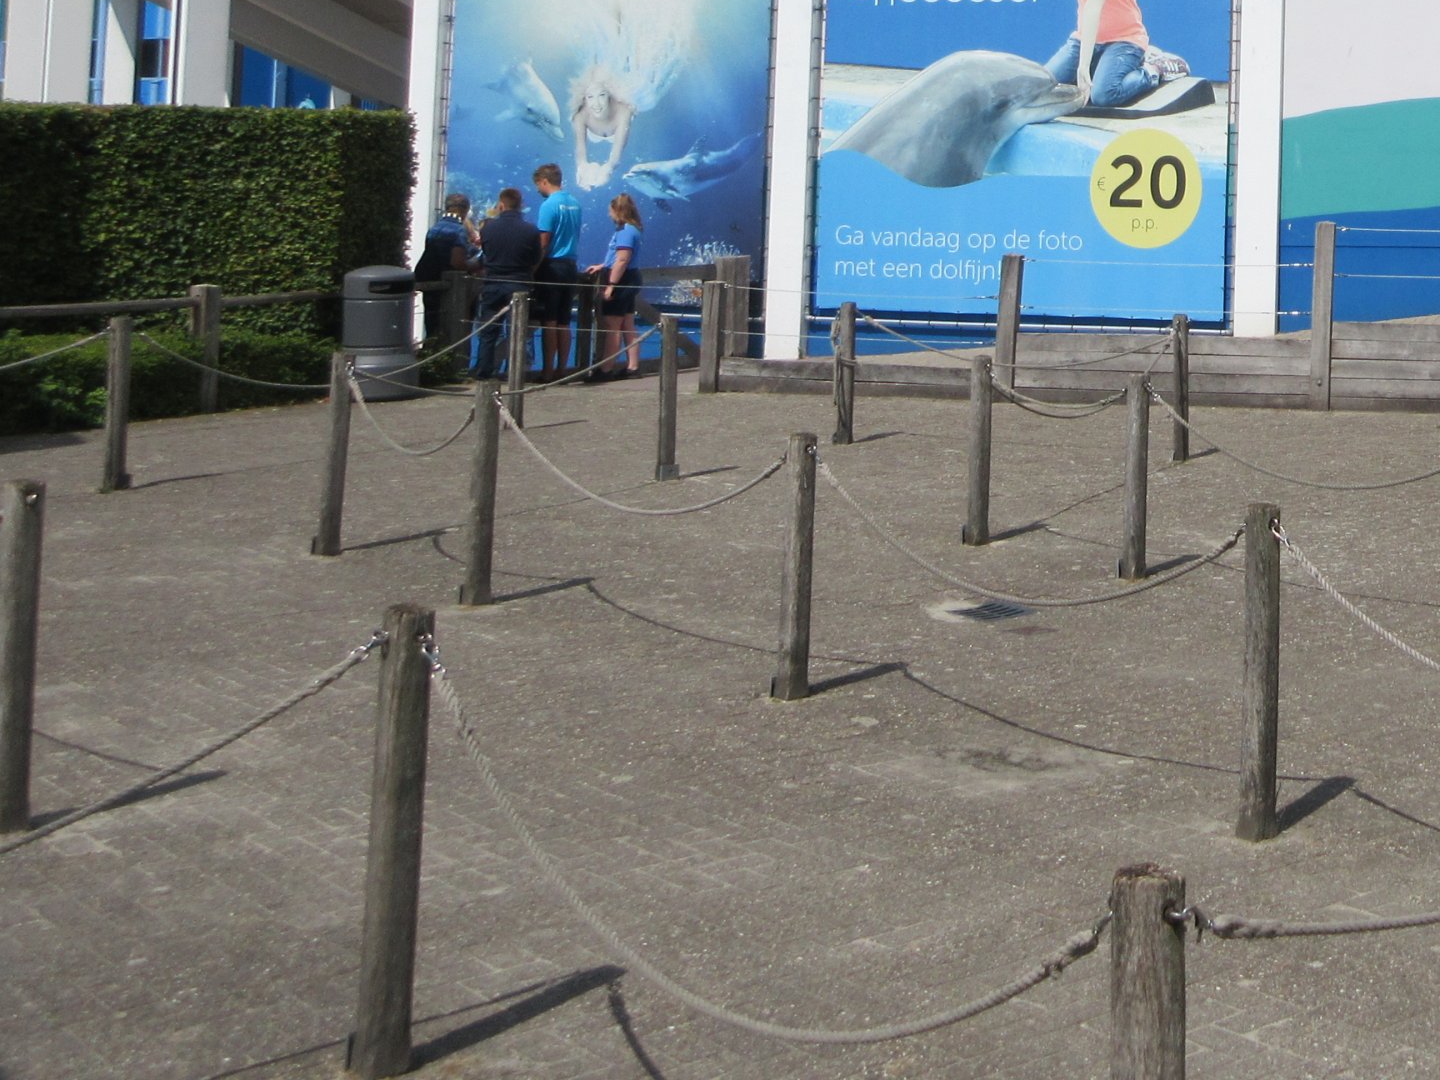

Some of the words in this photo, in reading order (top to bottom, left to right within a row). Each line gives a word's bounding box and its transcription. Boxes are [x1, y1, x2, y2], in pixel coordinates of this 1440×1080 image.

[1109, 154, 1187, 210] 20
[835, 224, 865, 246] Ga
[871, 227, 960, 253] vandaag
[968, 232, 997, 253] op
[1003, 229, 1031, 250] de
[1038, 229, 1084, 251] foto
[1131, 218, 1159, 233] p.p.
[834, 258, 876, 278] met
[882, 261, 923, 280] een
[929, 259, 1002, 286] dolfijn!
